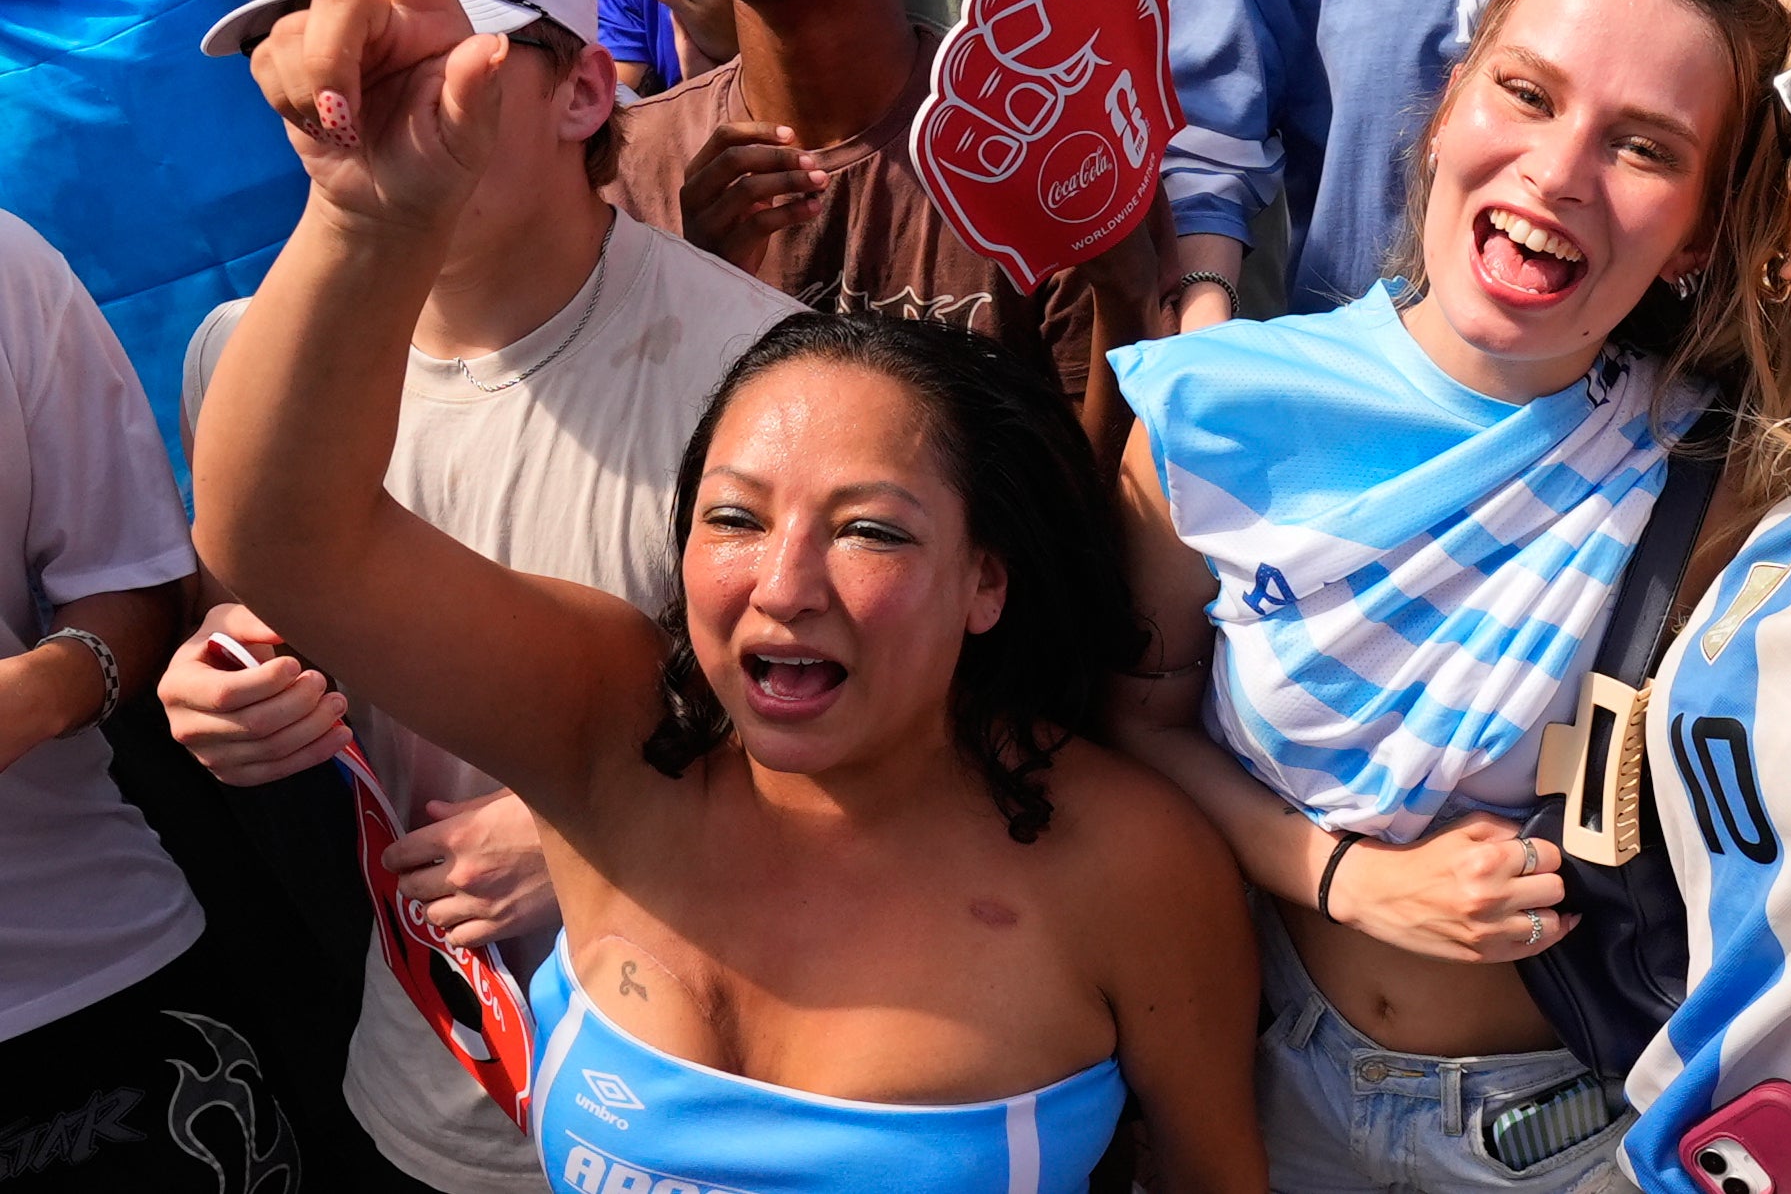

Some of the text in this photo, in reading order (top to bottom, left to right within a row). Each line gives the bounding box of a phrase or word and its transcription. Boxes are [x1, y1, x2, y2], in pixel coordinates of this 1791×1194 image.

[1071, 152, 1156, 252] WORLDWIDE PARTNER
[1671, 712, 1780, 864] 10
[575, 1092, 630, 1131] umbro
